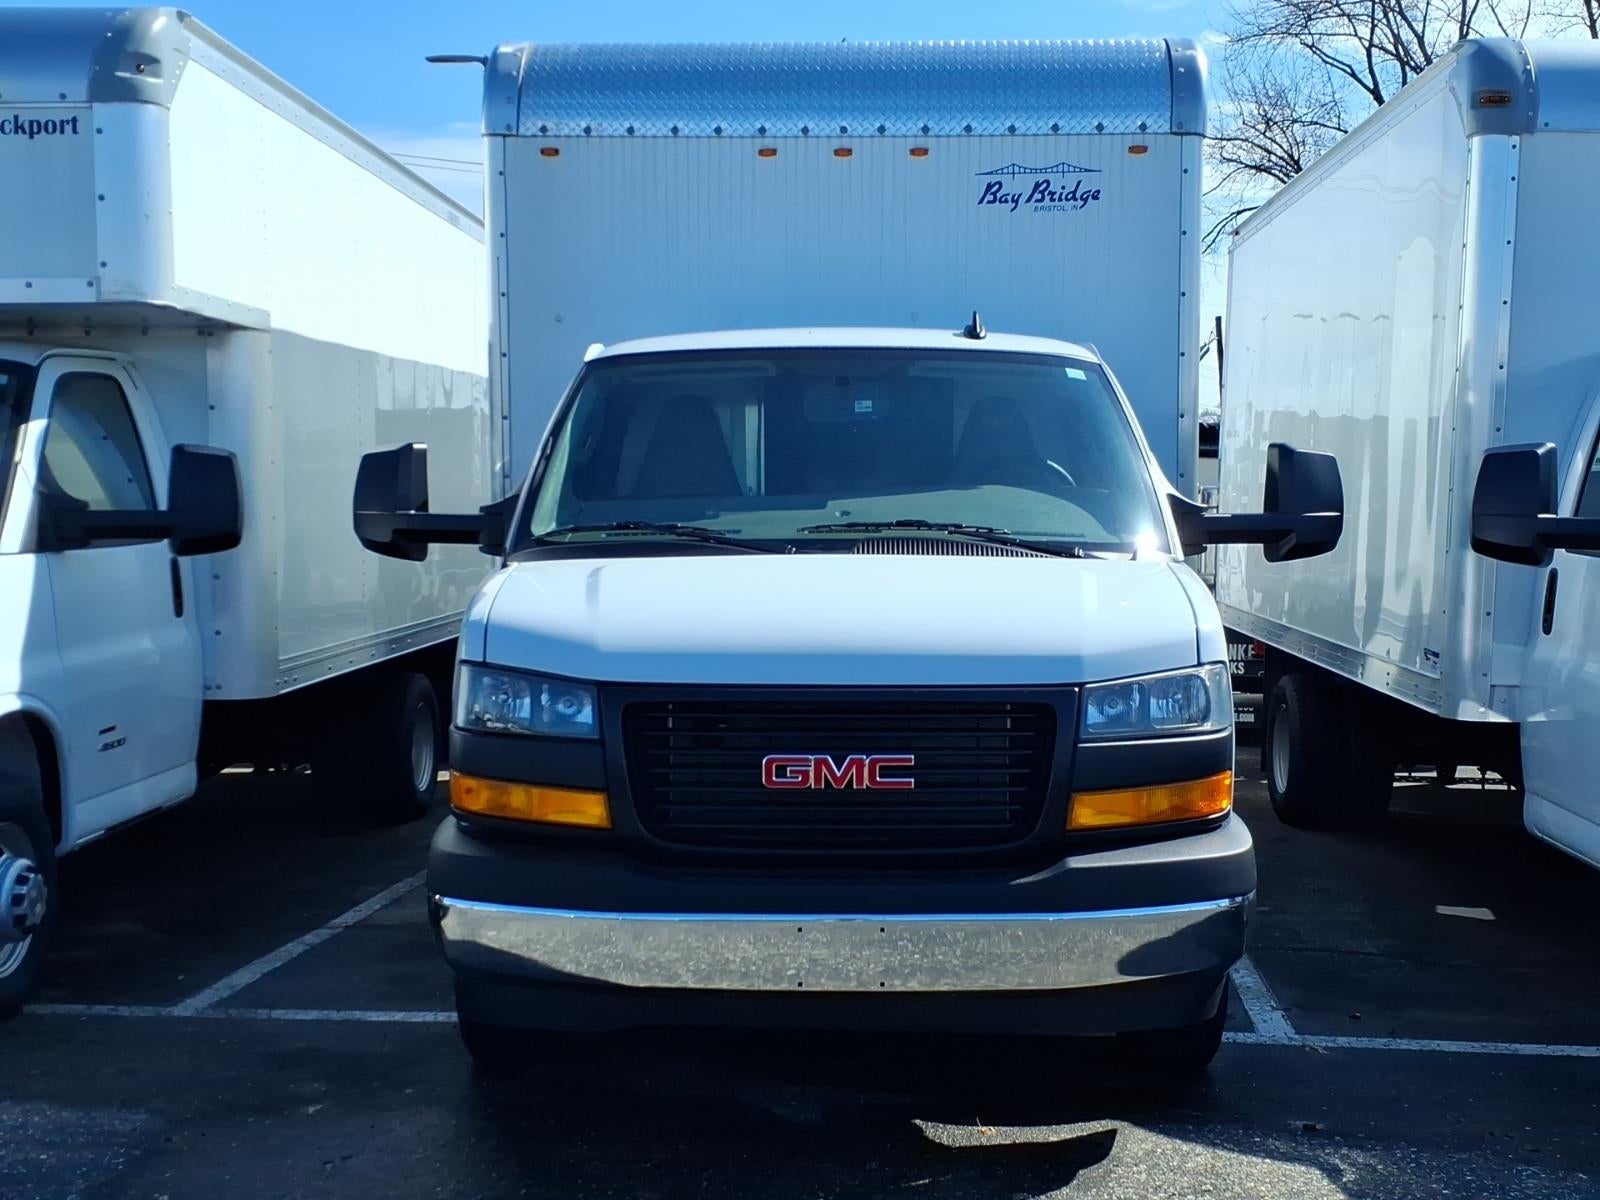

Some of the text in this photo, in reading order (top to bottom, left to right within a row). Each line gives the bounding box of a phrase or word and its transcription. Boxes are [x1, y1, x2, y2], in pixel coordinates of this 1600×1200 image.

[977, 179, 1101, 213] Bay Bridge
[762, 754, 915, 789] GMC
